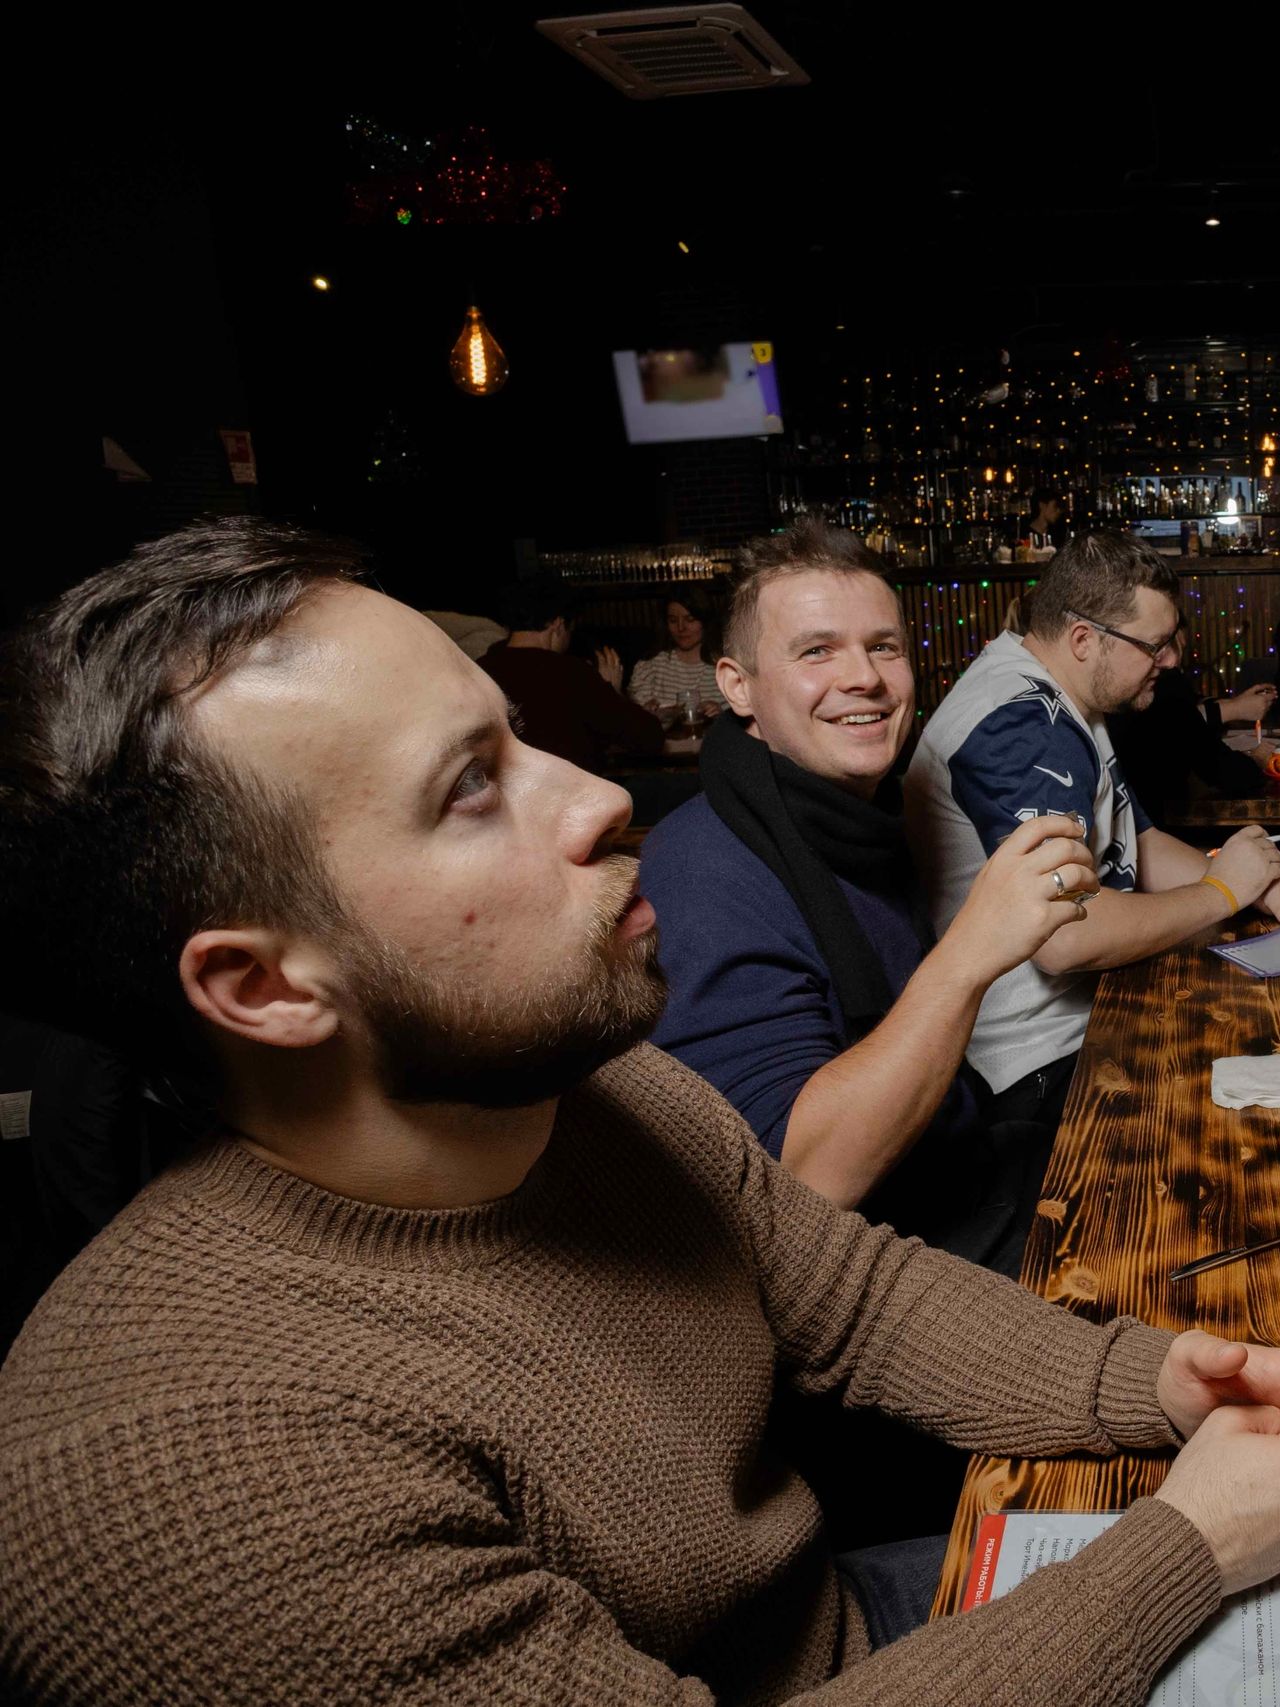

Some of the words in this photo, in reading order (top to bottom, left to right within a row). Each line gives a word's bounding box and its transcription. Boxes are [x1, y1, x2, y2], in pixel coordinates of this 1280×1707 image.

[983, 1538, 995, 1565] РЕЖИМ
[975, 1566, 989, 1599] РАБОТЫ:
[1256, 1623, 1264, 1675] баклажаном
